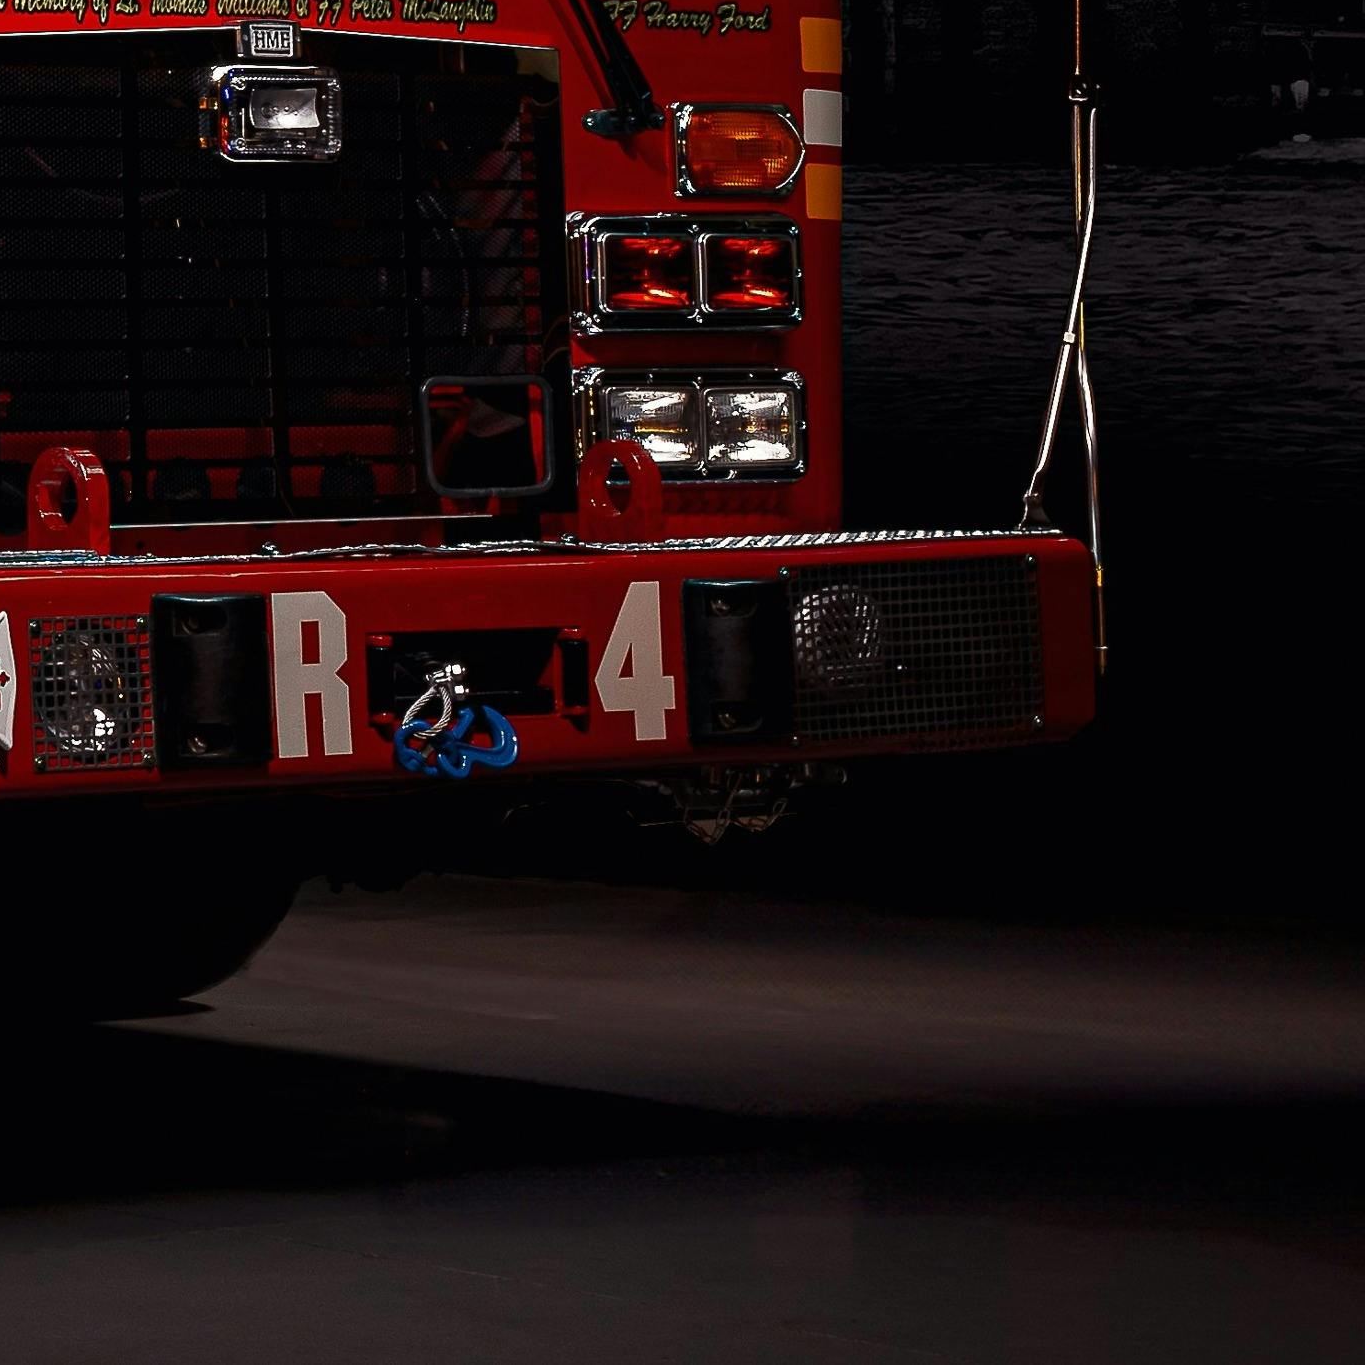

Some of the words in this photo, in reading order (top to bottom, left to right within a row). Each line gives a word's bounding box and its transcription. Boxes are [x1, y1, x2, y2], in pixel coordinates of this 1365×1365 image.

[603, 0, 638, 30] FF
[643, 0, 712, 35] Harry
[716, 3, 769, 33] Ford
[253, 30, 291, 50] HME
[271, 591, 352, 758] R
[595, 581, 675, 740] 4
